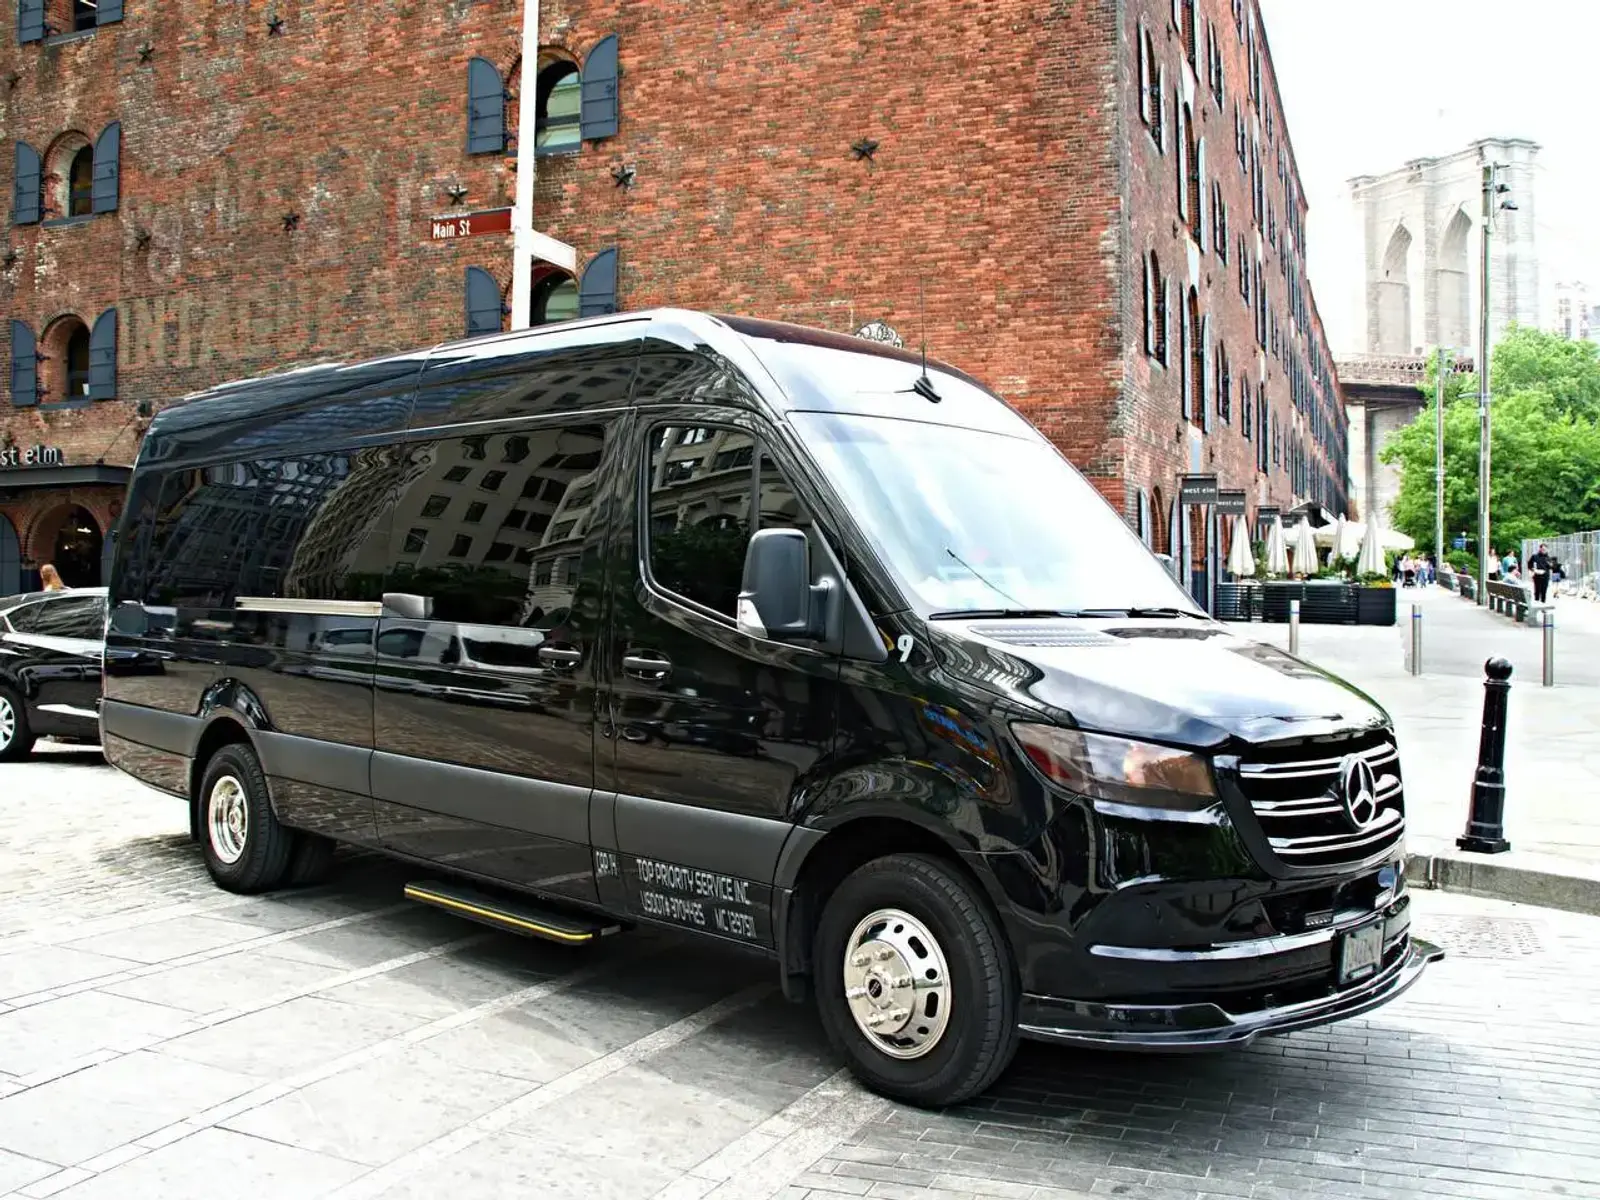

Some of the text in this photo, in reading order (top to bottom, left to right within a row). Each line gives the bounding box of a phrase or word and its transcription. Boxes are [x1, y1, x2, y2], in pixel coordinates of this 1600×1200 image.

[433, 220, 470, 239] Main St
[25, 444, 58, 465] elm
[897, 634, 914, 663] 9
[636, 858, 752, 905] TOP PRIORITY SERVICE INC
